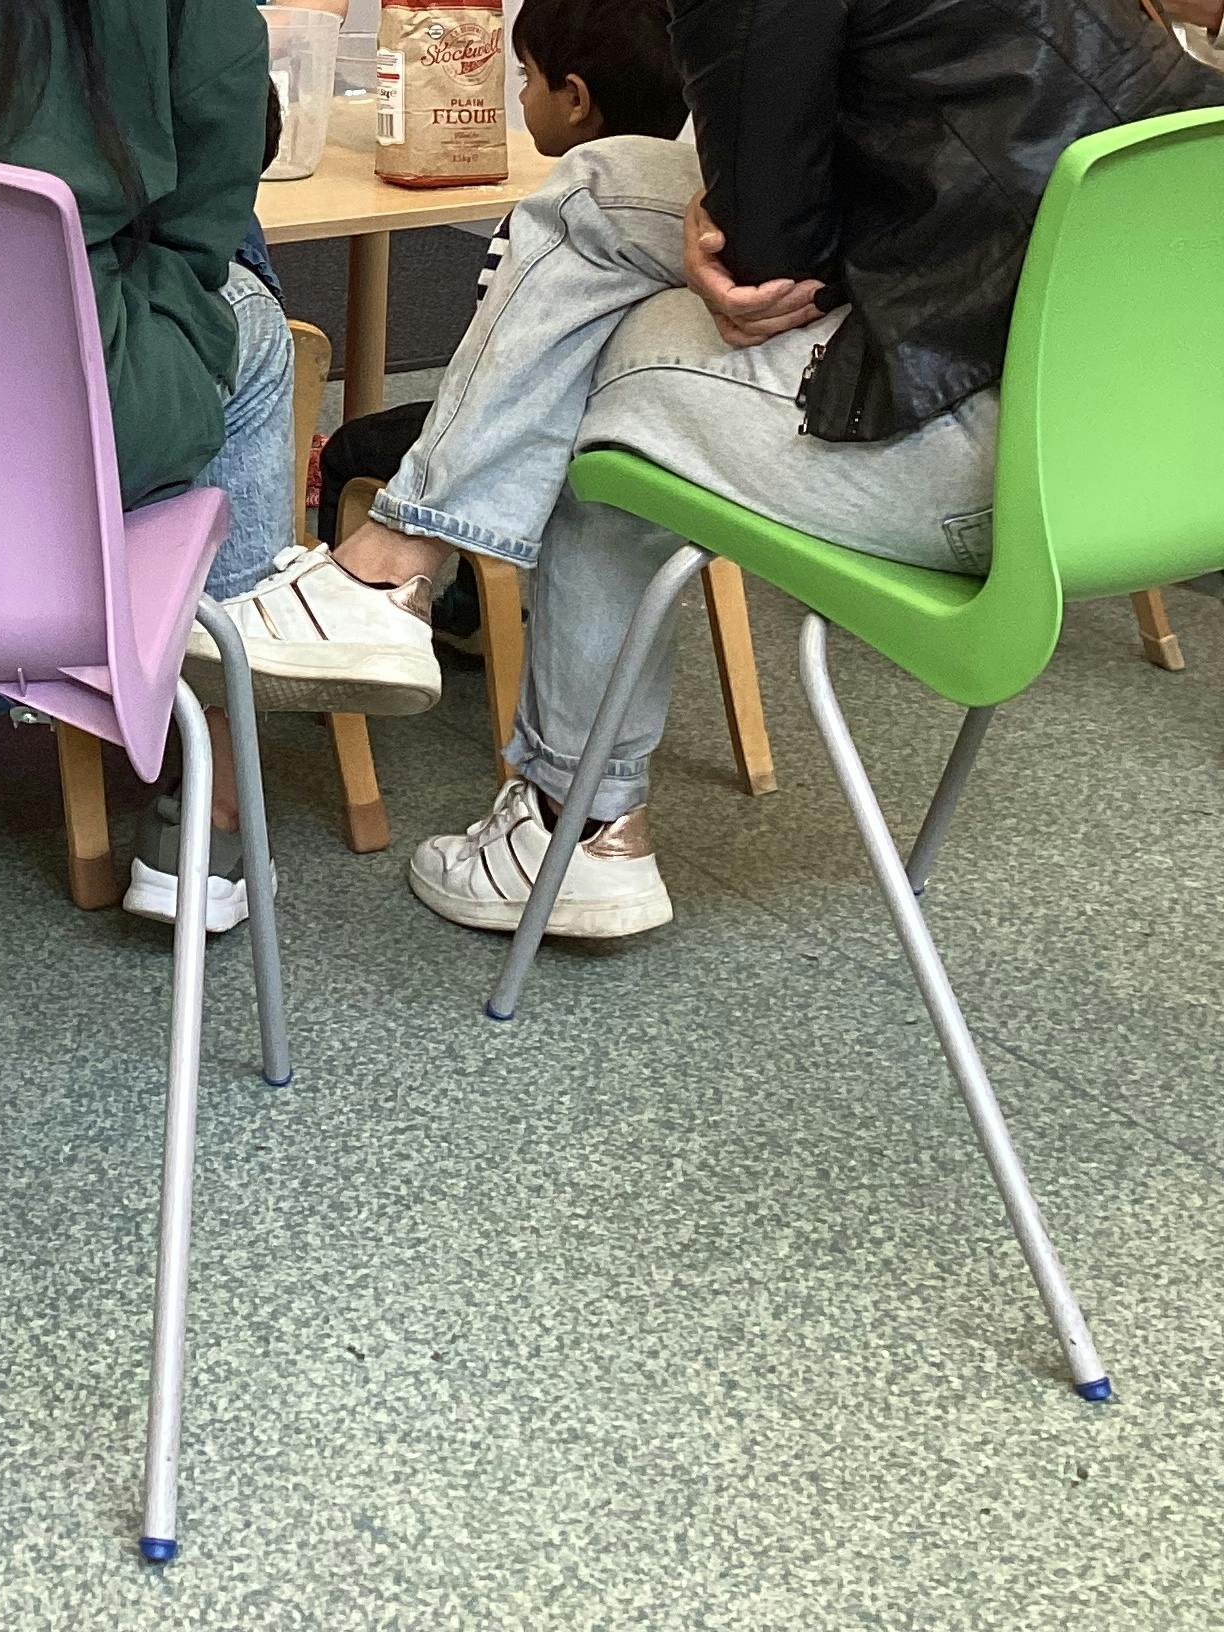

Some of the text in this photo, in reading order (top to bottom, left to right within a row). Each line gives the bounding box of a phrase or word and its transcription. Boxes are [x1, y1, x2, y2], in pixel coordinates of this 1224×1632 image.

[420, 27, 503, 67] Stockwell
[450, 98, 484, 107] PLAIN
[432, 108, 497, 125] FLOUR
